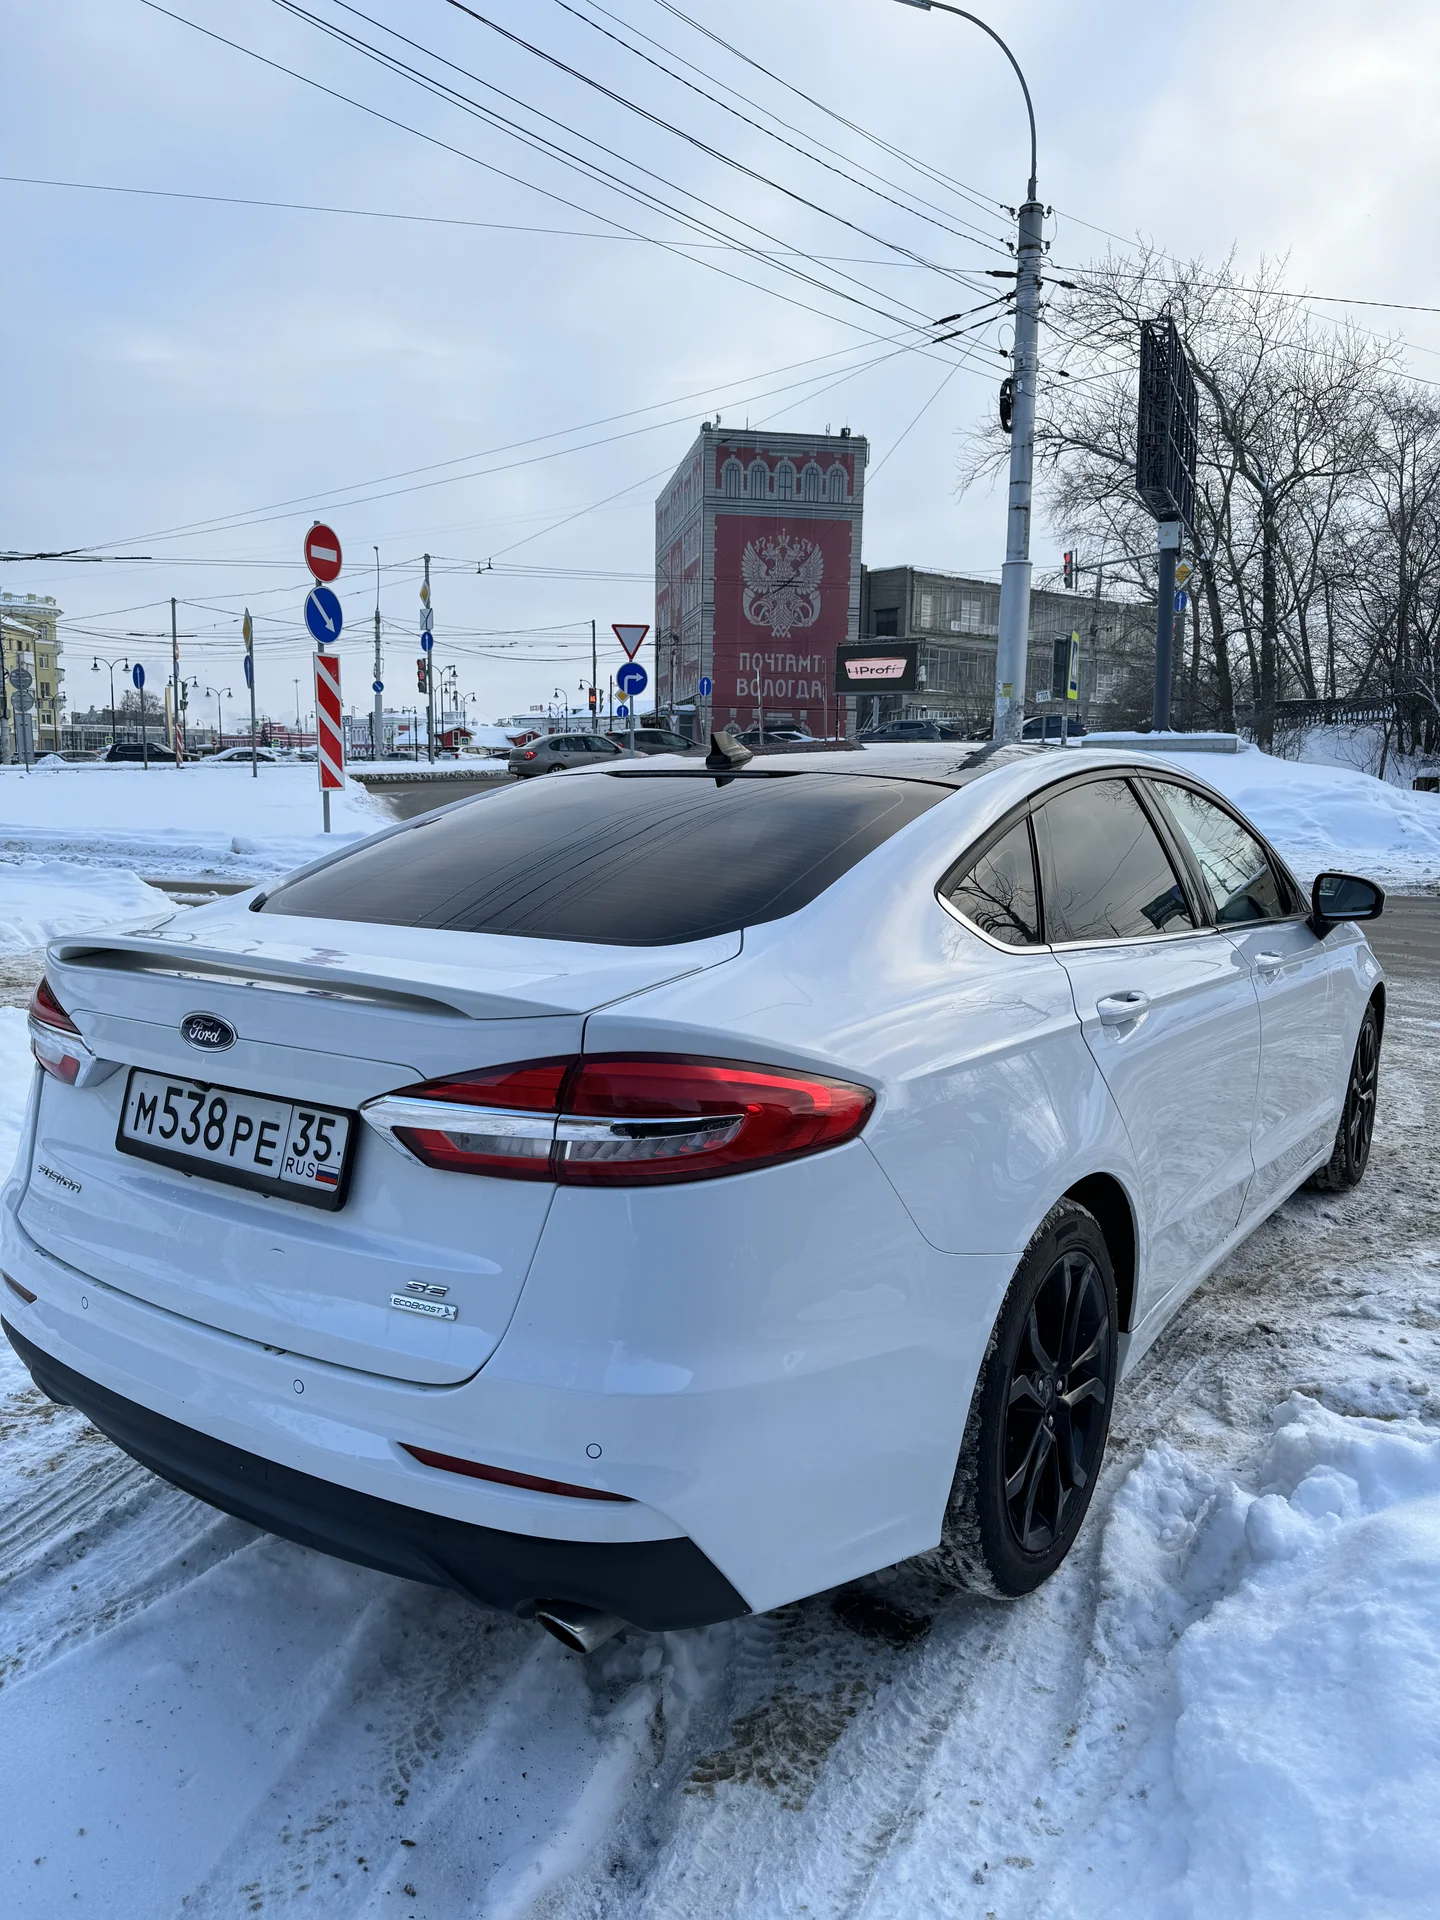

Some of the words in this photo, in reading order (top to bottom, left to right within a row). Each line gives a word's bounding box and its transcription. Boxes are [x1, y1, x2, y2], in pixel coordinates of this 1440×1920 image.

[739, 652, 821, 673] ПОЧТАМТ
[736, 678, 823, 699] ВОЛОГДА
[189, 1018, 221, 1043] Ford
[292, 1112, 336, 1161] 35
[284, 1156, 316, 1178] RUS
[404, 1280, 450, 1297] SE
